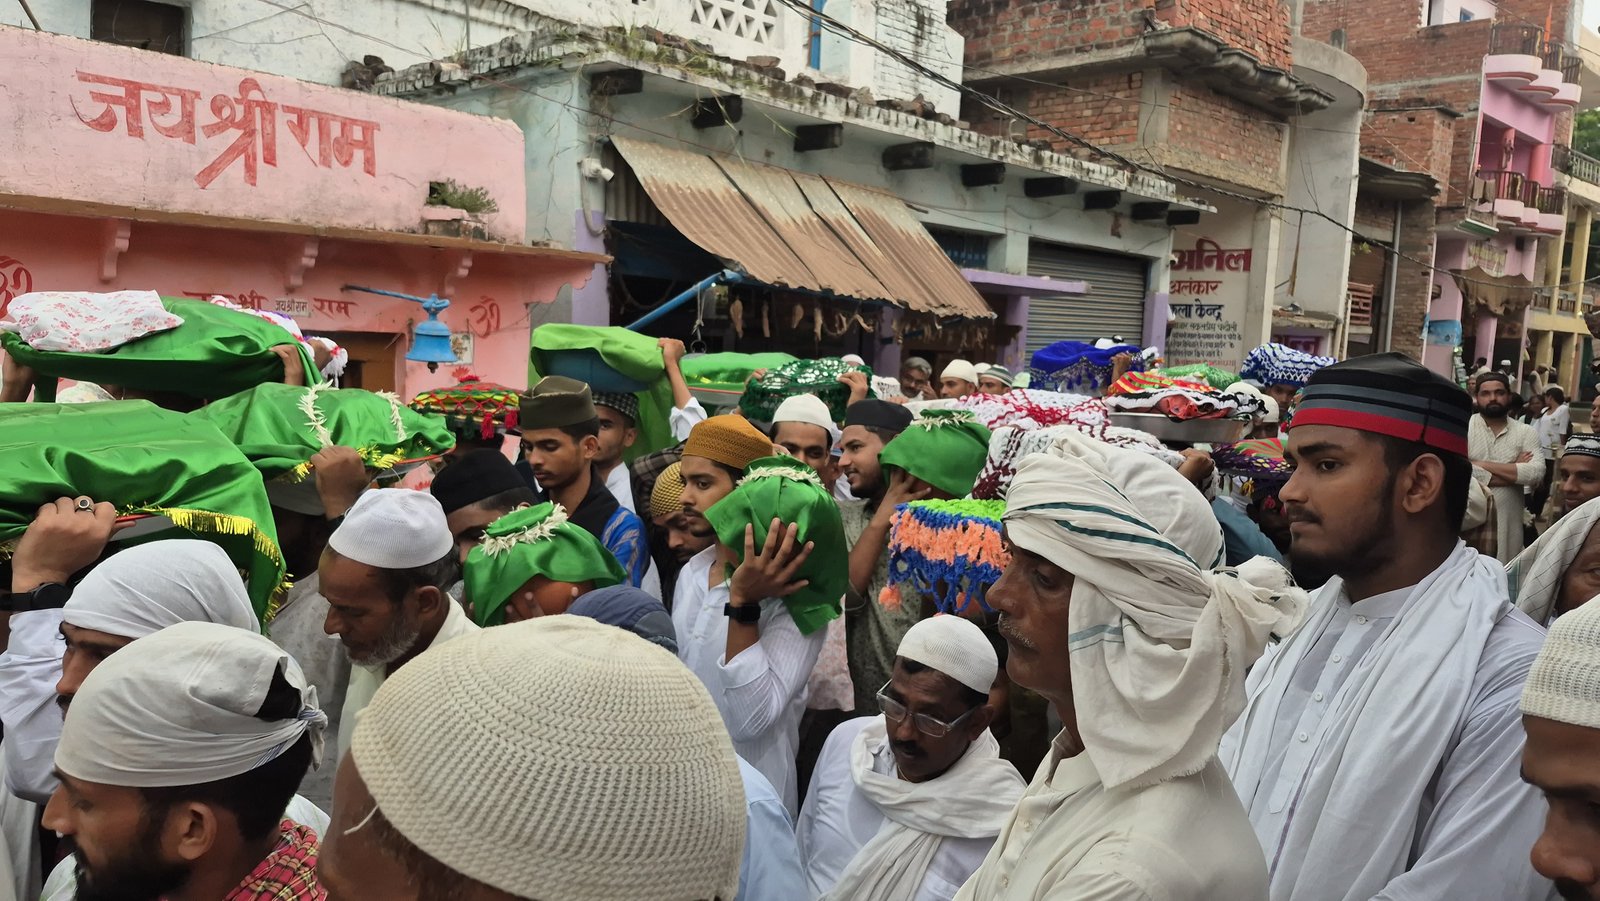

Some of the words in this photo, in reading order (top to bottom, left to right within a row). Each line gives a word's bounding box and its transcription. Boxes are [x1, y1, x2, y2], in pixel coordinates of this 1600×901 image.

[69, 70, 201, 144] जय
[194, 77, 279, 189] श्री
[281, 104, 381, 177] राम
[1170, 238, 1252, 271] अनिल
[1169, 277, 1223, 296] अलंकार
[313, 298, 359, 319] राम
